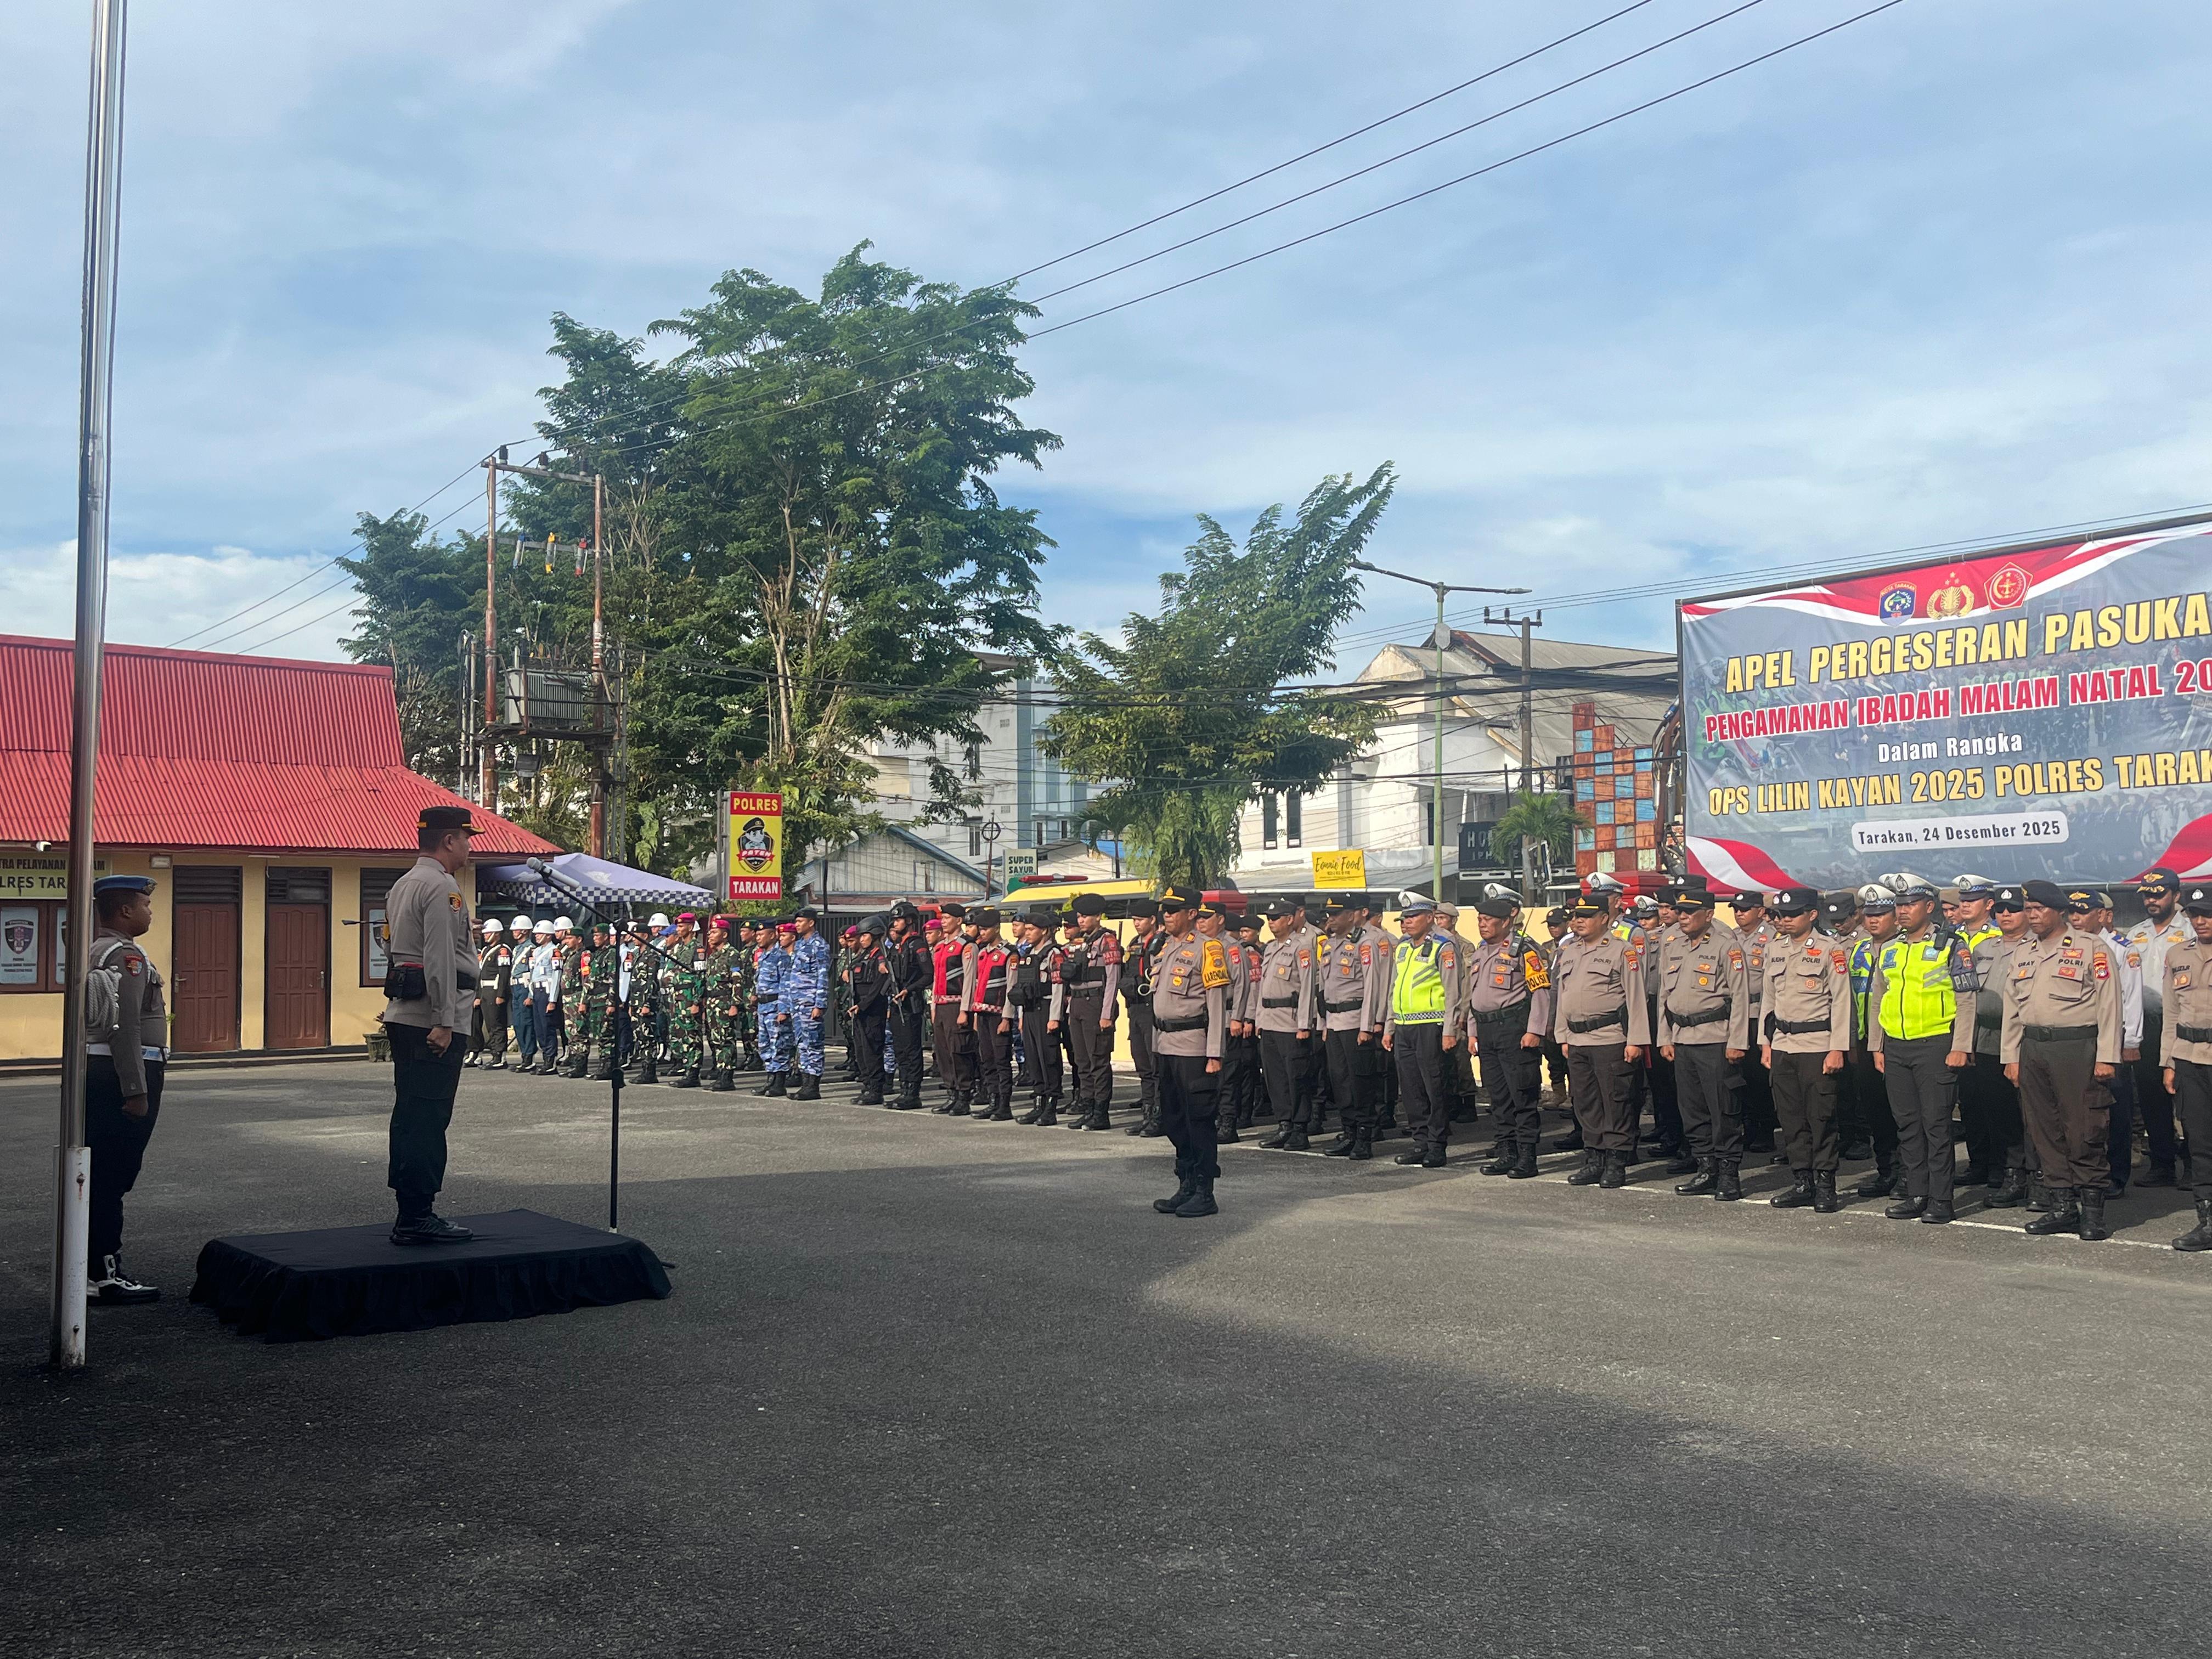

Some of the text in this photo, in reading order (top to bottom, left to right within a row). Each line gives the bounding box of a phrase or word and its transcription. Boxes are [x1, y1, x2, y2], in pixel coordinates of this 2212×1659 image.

[1725, 592, 2212, 693] APEL PERGESERAN PASUKA
[1705, 658, 2212, 743] PENGAMANAN IBADAH MALAM NATAL 20
[1878, 732, 2023, 763] Dalam Rangka
[1708, 748, 2212, 816] OPS LILIN KAYAN 2025 POLRES TARAK
[733, 797, 778, 811] POLRES
[1858, 821, 2061, 844] Tarakan, 24 Desember 2025
[17, 859, 66, 870] PELAYANAN
[1008, 856, 1034, 864] SUPER
[1341, 856, 1362, 872] Food
[0, 876, 34, 889] LRES
[733, 881, 778, 894] TARAKAN
[498, 956, 510, 966] PM
[1175, 957, 1193, 966] POLRI
[1527, 974, 1547, 988] POLISI
